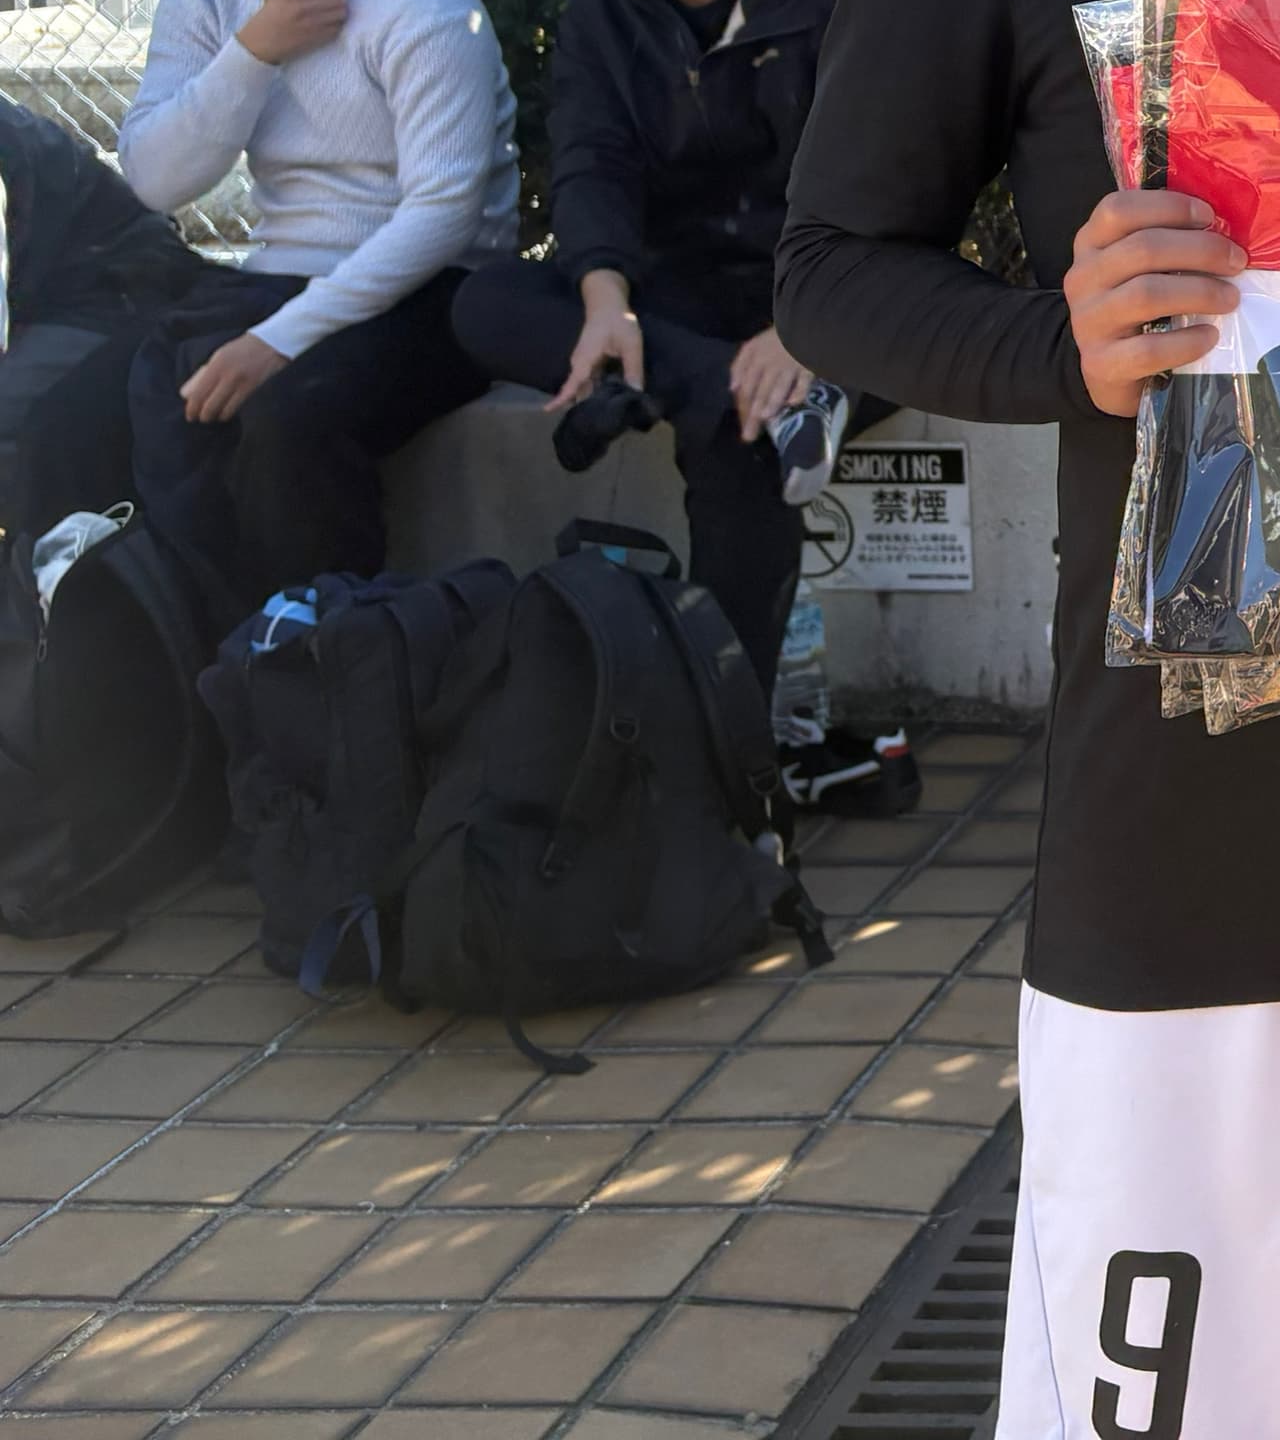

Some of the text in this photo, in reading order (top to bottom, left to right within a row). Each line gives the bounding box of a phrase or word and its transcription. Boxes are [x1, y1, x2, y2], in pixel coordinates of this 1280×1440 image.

[839, 453, 943, 481] SMOKING
[872, 488, 949, 525] 禁煙
[1091, 1249, 1202, 1440] 9
